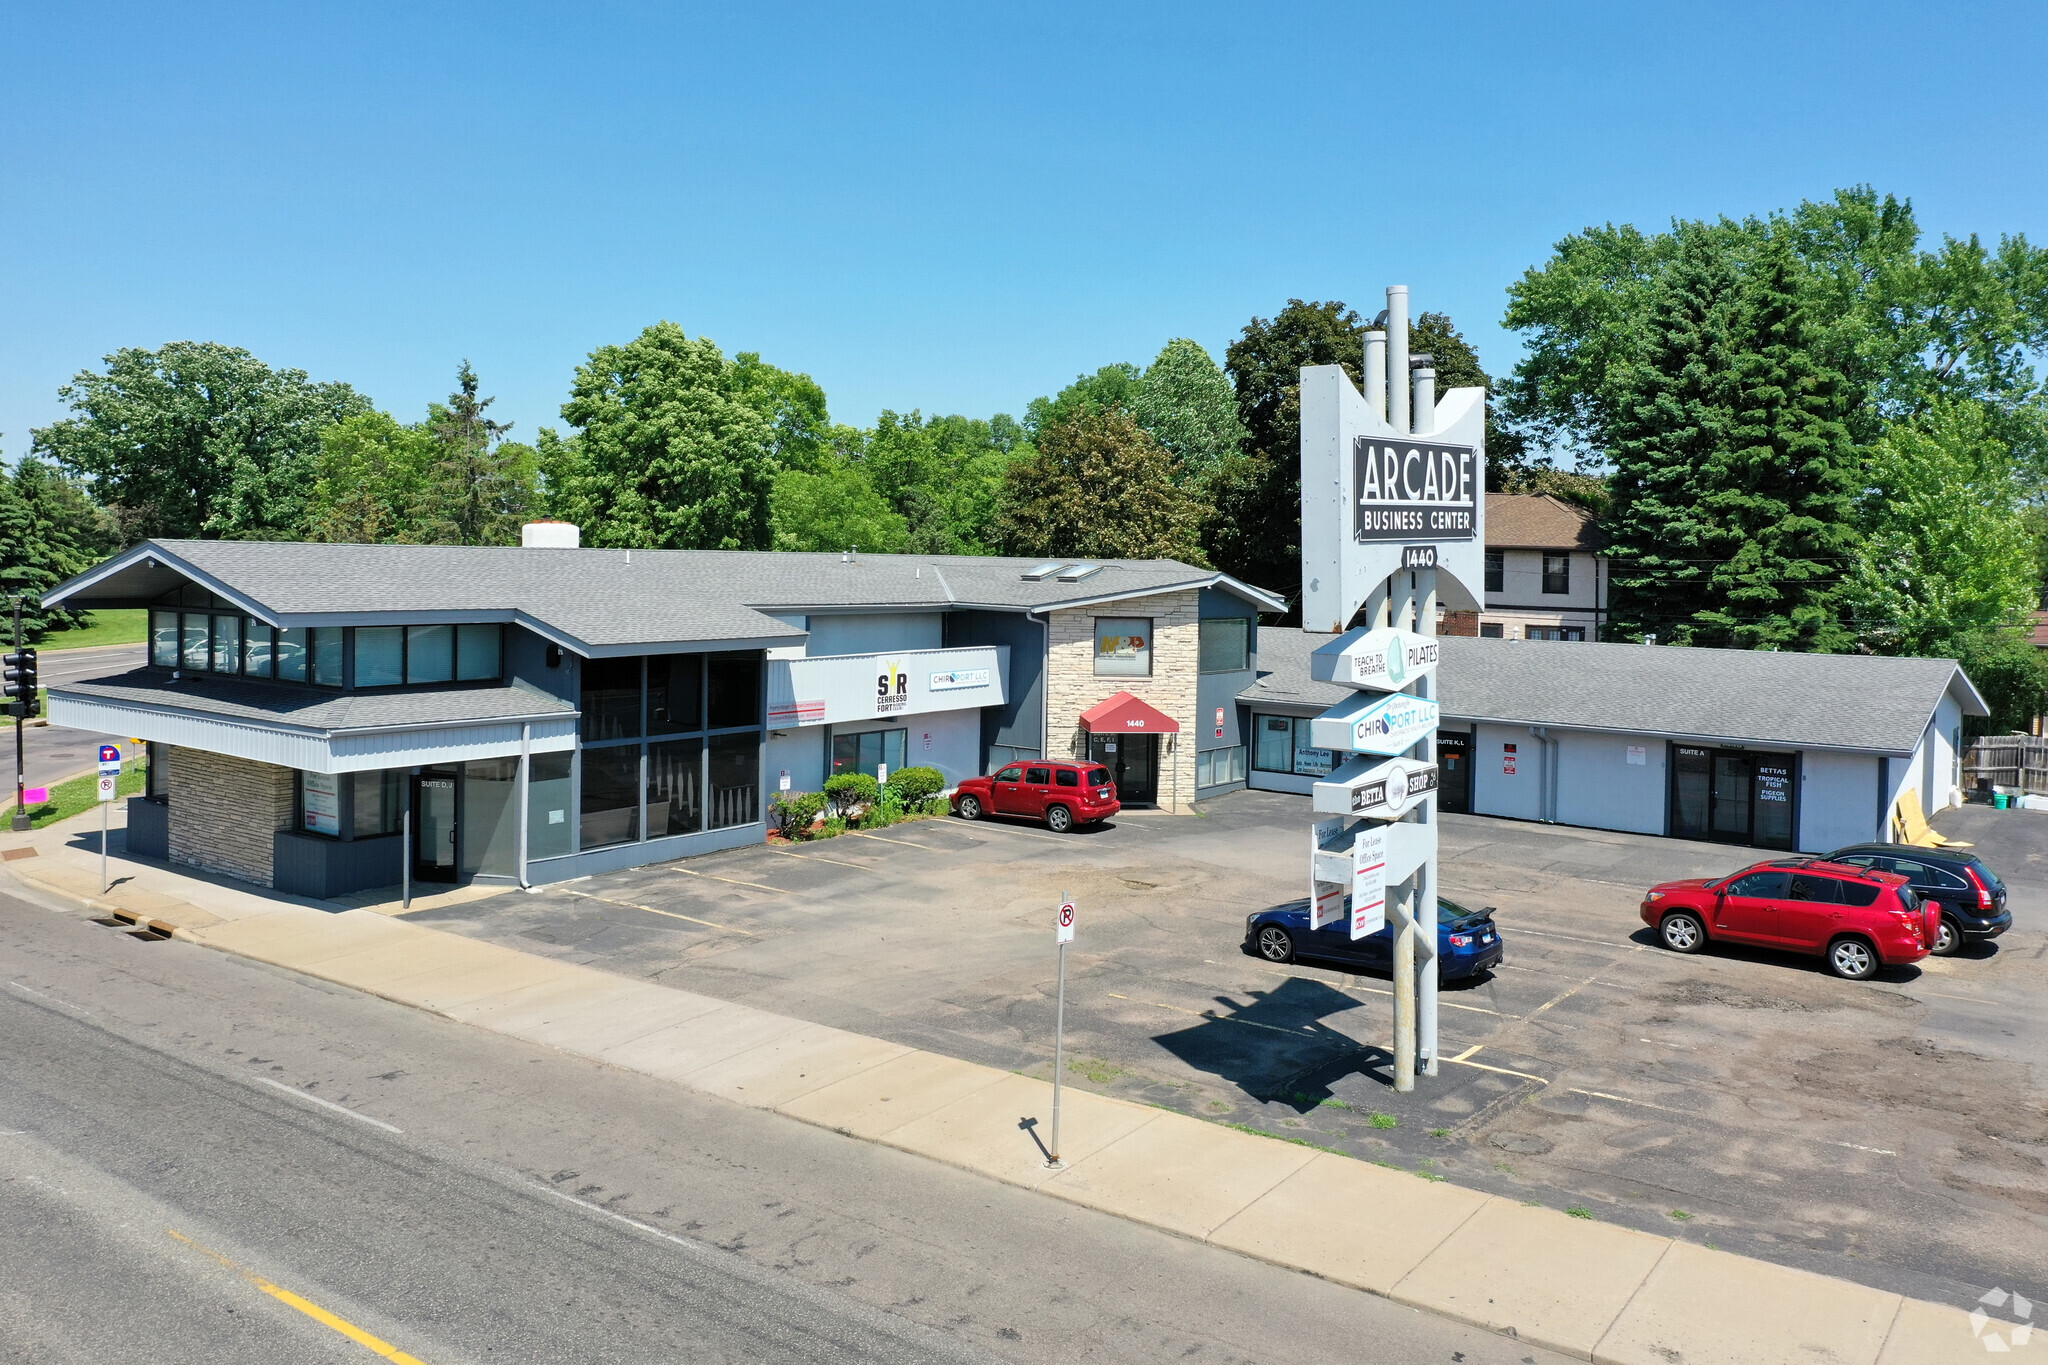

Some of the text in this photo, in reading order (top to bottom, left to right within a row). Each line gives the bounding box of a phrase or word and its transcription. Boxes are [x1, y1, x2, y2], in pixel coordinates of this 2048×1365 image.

[1362, 446, 1470, 501] ARCADE
[1364, 511, 1470, 530] BUSINESS CENTER
[1406, 549, 1434, 567] 1440
[1354, 653, 1383, 667] TEACH TO
[1408, 644, 1438, 666] PILATES
[975, 671, 987, 680] LLC
[1360, 663, 1386, 676] BREATHE
[877, 694, 907, 705] CERRESSO
[877, 703, 892, 713] FORT
[1418, 705, 1435, 723] LLC
[1299, 749, 1330, 758] Anthony Lee
[1680, 748, 1698, 756] SUITE
[1760, 767, 1787, 775] BETTAS
[421, 780, 440, 788] SUITE
[1758, 775, 1789, 784] TROPICAL
[1361, 774, 1428, 806] BETTA SHOP
[1318, 827, 1338, 839] For Lease
[1370, 837, 1381, 847] Lease
[1359, 850, 1384, 864] Office Space
